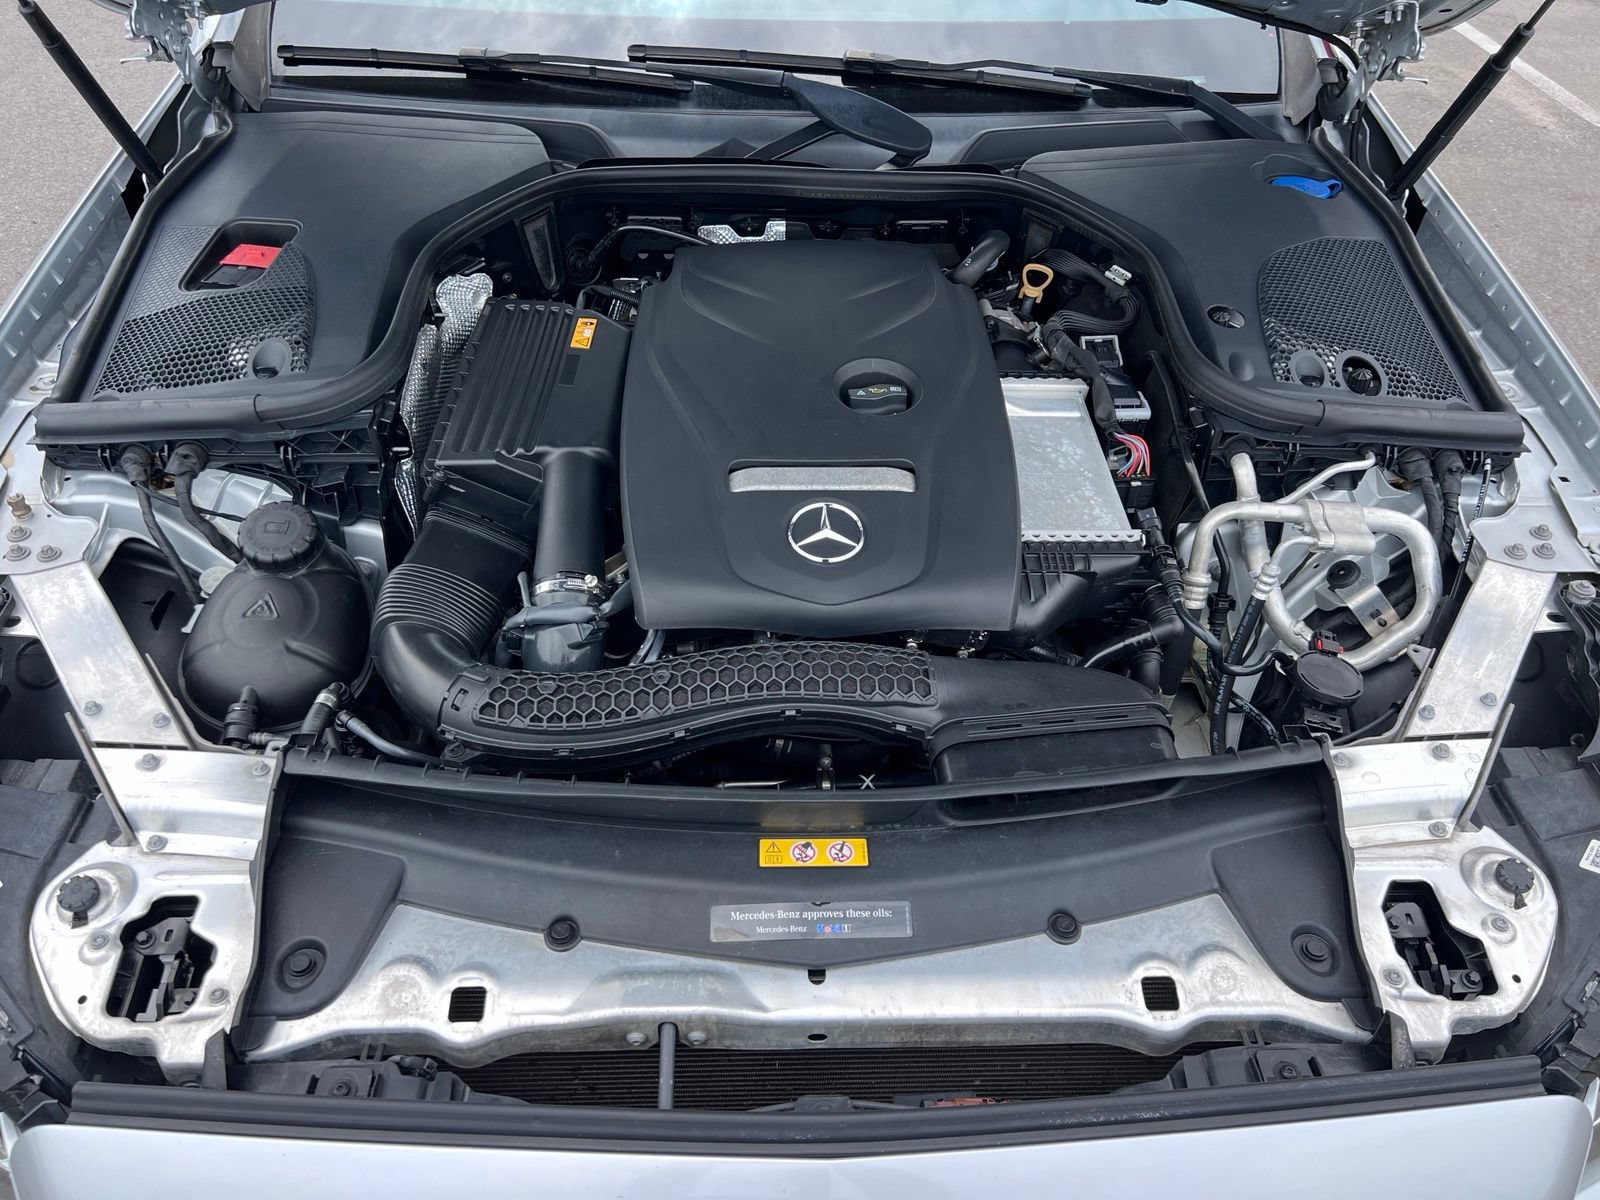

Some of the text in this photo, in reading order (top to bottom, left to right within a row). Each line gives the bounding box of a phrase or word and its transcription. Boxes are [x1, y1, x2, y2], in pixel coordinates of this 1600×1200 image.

[730, 908, 893, 921] Mercedes-Benz approves these oils:
[756, 925, 808, 934] Mercedes-Benz
